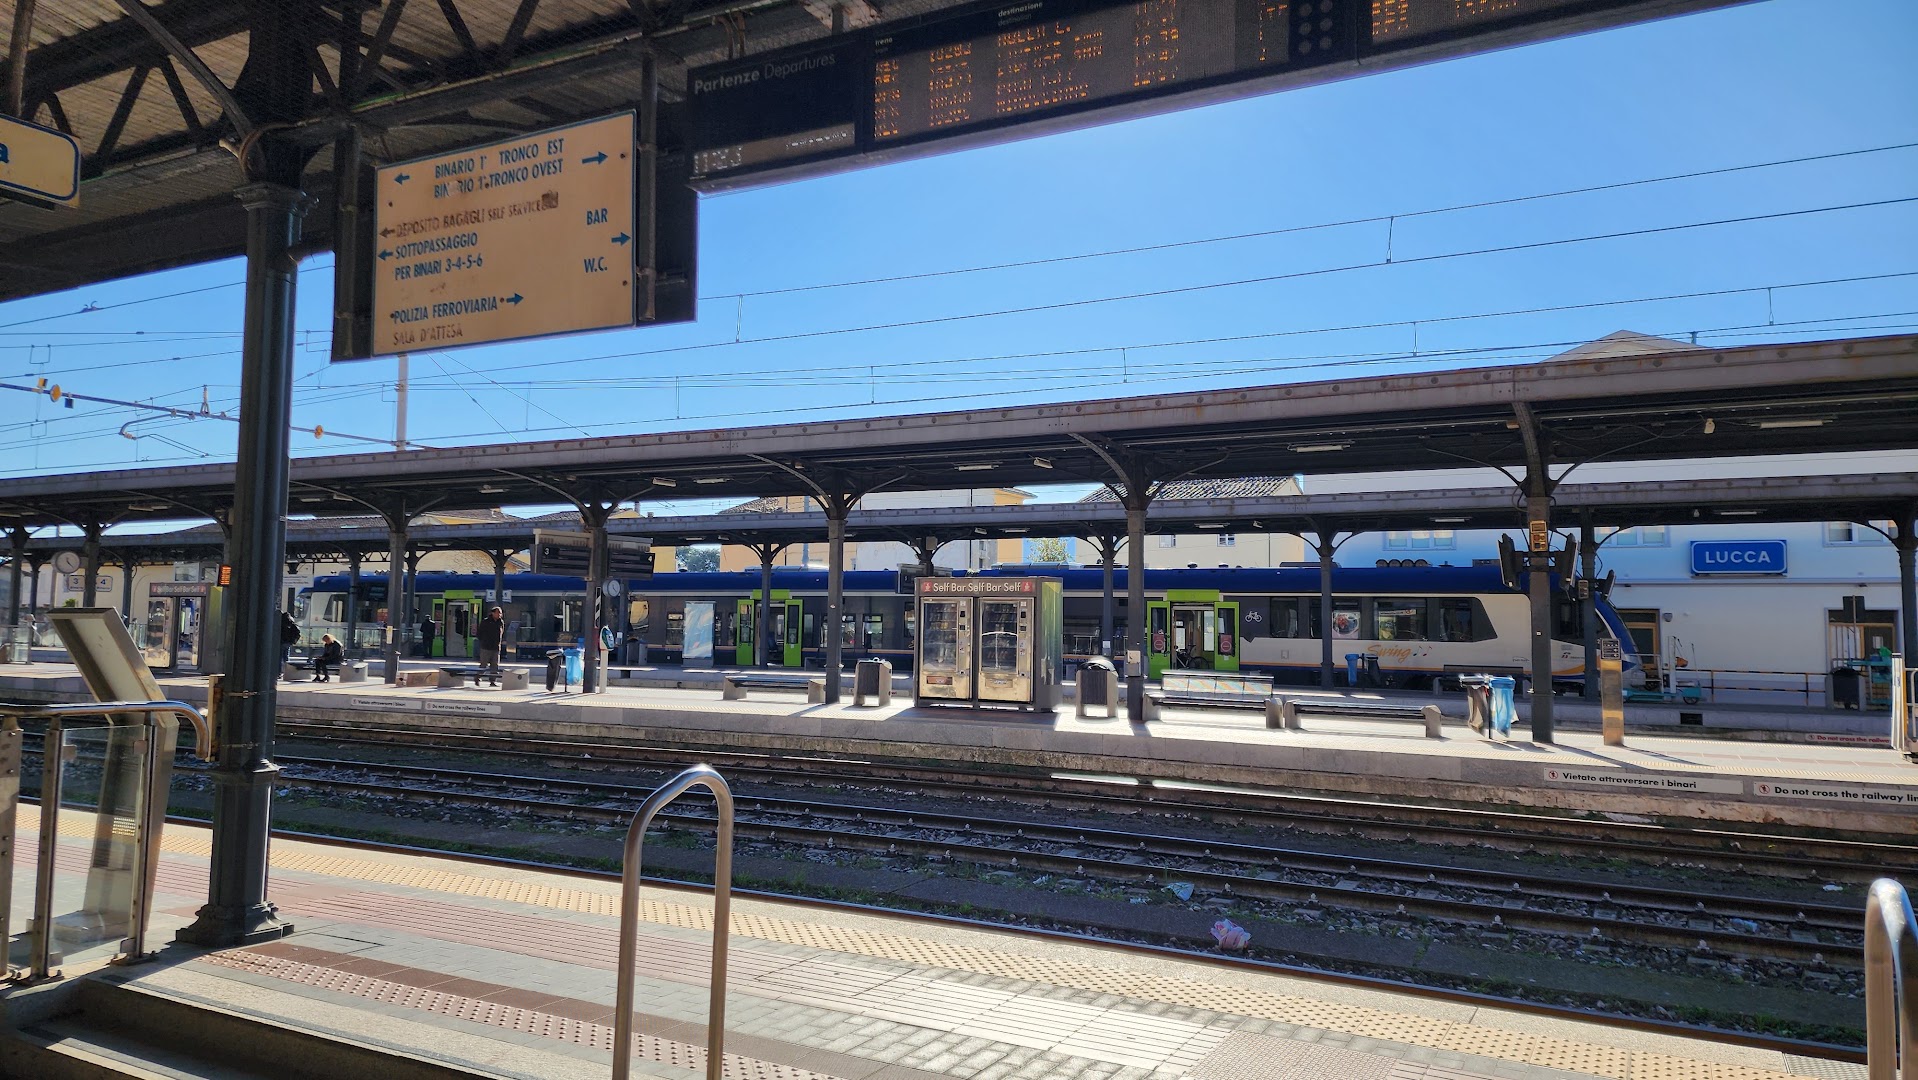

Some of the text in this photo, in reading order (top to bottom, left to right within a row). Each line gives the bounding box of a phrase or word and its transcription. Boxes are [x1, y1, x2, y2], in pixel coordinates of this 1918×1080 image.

[694, 53, 836, 95] Partenze Departures
[435, 158, 475, 179] BINARIO
[499, 143, 539, 166] TRONCO
[547, 138, 565, 156] EST
[434, 178, 474, 198] BINRIO
[489, 166, 529, 188] TRONCO
[532, 158, 563, 179] OVEST
[396, 199, 541, 238] DEPOSITO BAGAGLI SELF SERVICE
[586, 207, 608, 226] BAR
[395, 232, 478, 260] SOTTOPASSAGGIO
[395, 253, 483, 281] PER BINARI 3-4-5-6
[583, 256, 608, 273] W.C.
[394, 296, 498, 324] POLIZIA FERROVIARIA
[545, 547, 550, 555] 3
[1705, 550, 1771, 564] LUCCA
[73, 577, 79, 585] 3
[933, 581, 1021, 592] Self Bar Self Bar Self
[1367, 644, 1412, 663] Swing
[1562, 772, 1597, 782] Vietato
[1599, 774, 1659, 786] attraversare
[1667, 779, 1697, 788] binari
[1774, 786, 1789, 794] Do
[1792, 788, 1809, 796] not
[1812, 790, 1838, 798] cross
[1841, 790, 1859, 799] the
[1862, 792, 1904, 803] railway
